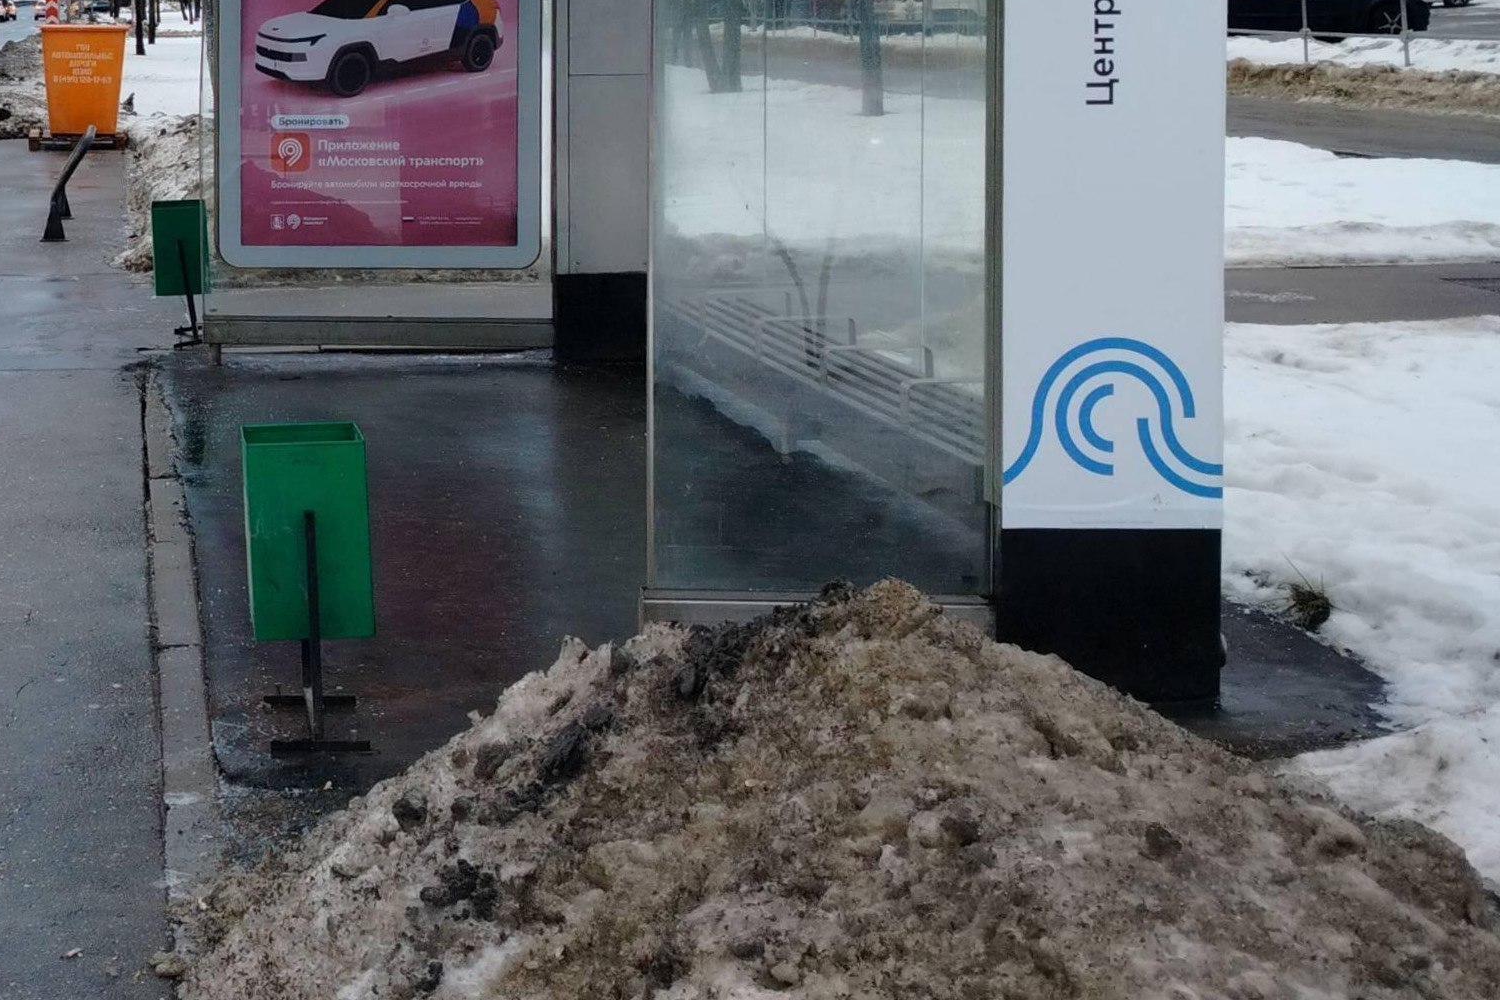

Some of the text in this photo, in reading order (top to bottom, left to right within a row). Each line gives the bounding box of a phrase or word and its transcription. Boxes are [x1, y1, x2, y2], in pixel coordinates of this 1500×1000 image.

[278, 115, 344, 127] Бронировать
[318, 140, 400, 153] Приложение
[318, 155, 484, 168] «Московский транспорт»
[271, 180, 483, 190] Бронируйте автомобили краткосрочной аренды
